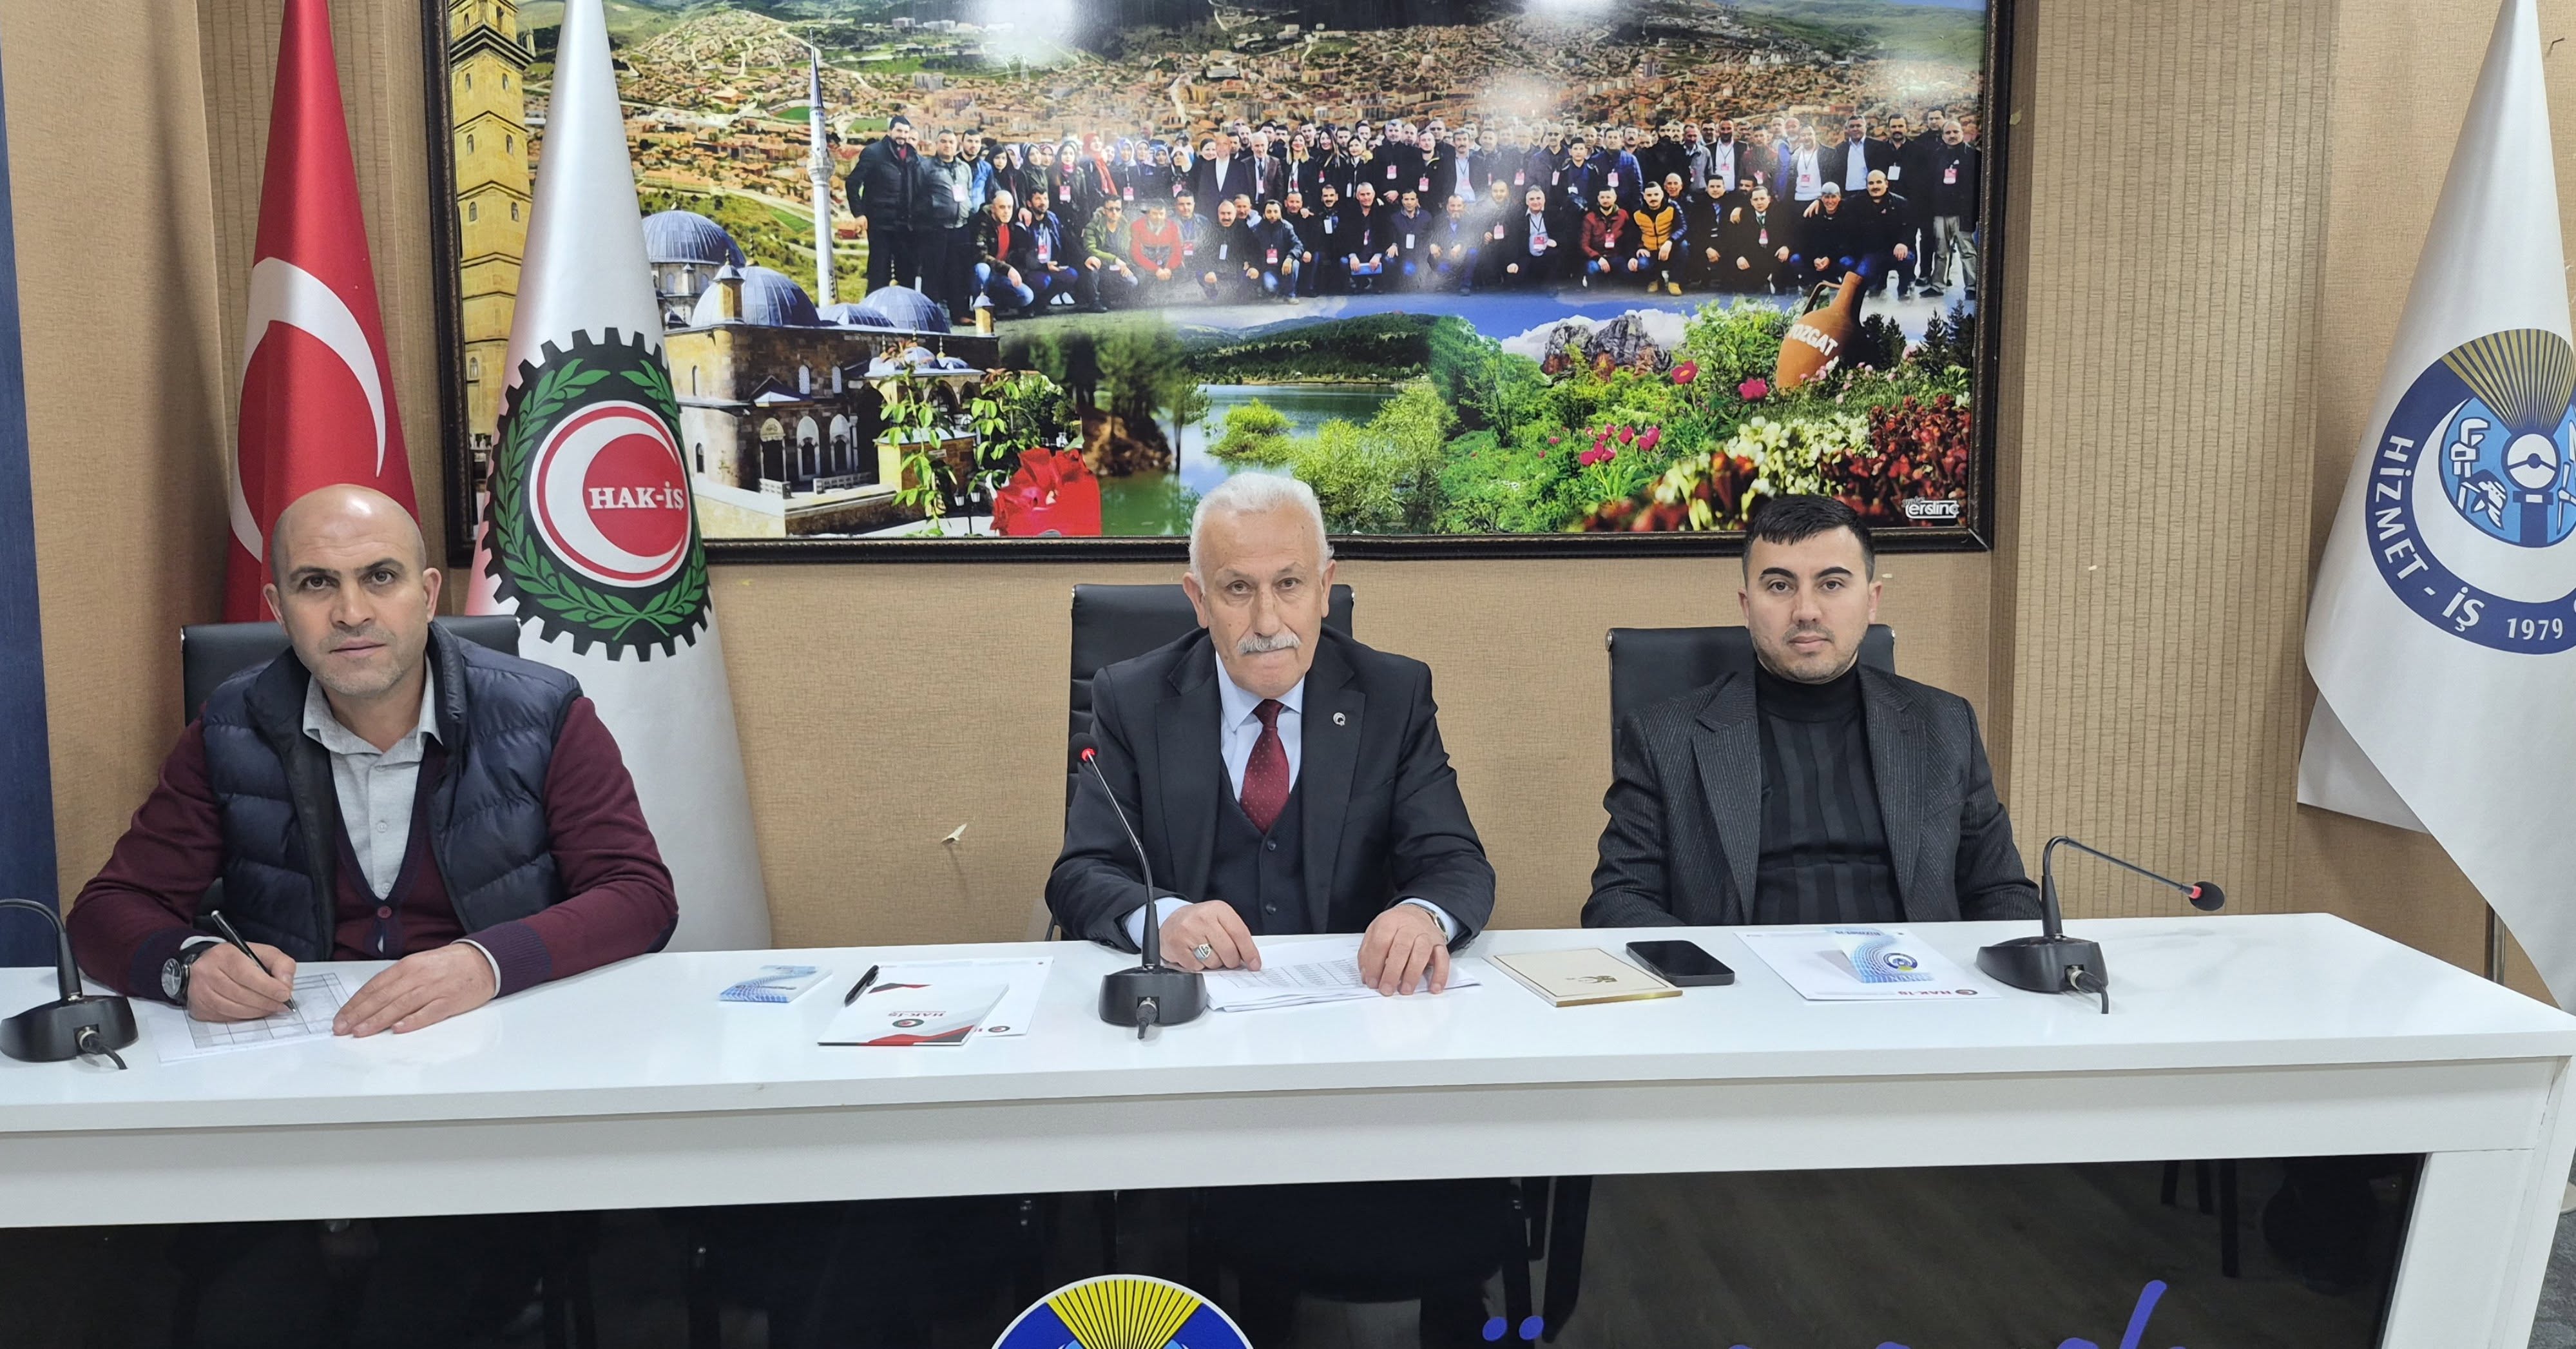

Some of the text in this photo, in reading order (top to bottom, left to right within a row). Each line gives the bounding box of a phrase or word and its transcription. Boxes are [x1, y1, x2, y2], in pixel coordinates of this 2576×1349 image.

[588, 481, 684, 510] HAK-İŞ
[2375, 435, 2428, 580] HİZMET
[2442, 587, 2485, 632] İŞ
[2507, 617, 2563, 640] 1979
